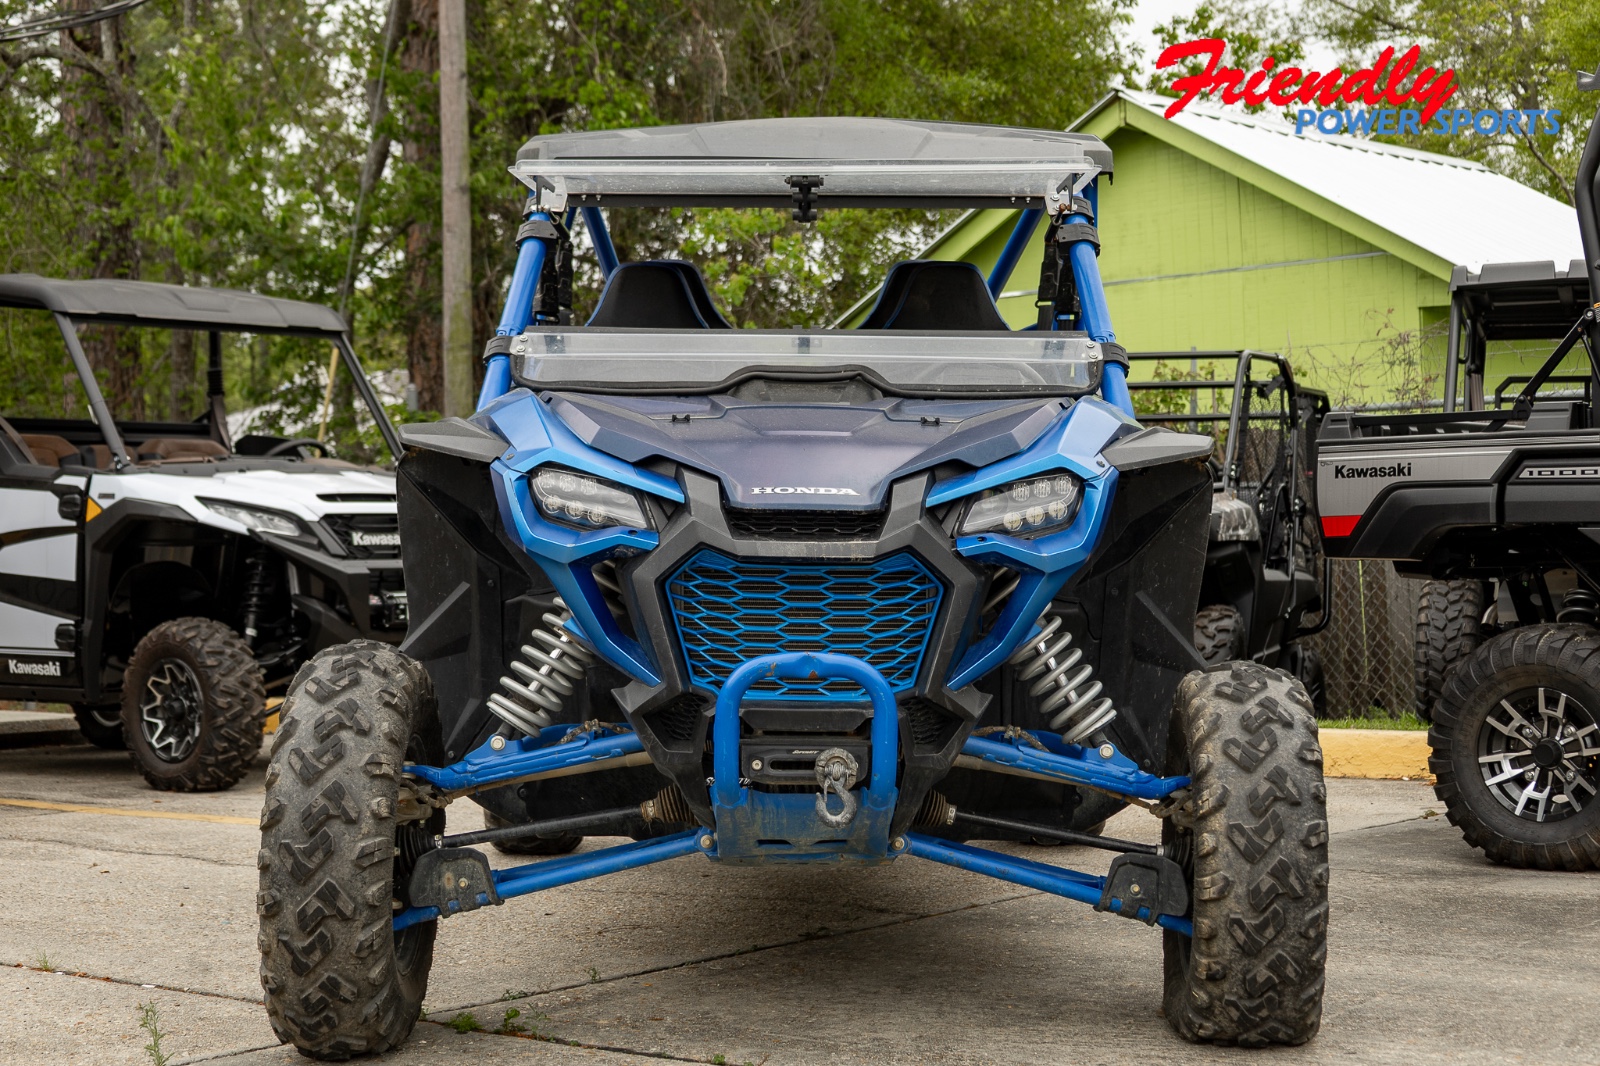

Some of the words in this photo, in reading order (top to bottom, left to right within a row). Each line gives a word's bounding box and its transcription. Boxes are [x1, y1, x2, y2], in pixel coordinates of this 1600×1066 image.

[1334, 462, 1412, 479] Kawasaki
[1527, 469, 1599, 477] 1000
[751, 486, 861, 496] HONDA
[352, 531, 401, 546] Kawasa
[8, 659, 61, 676] Kawasaki
